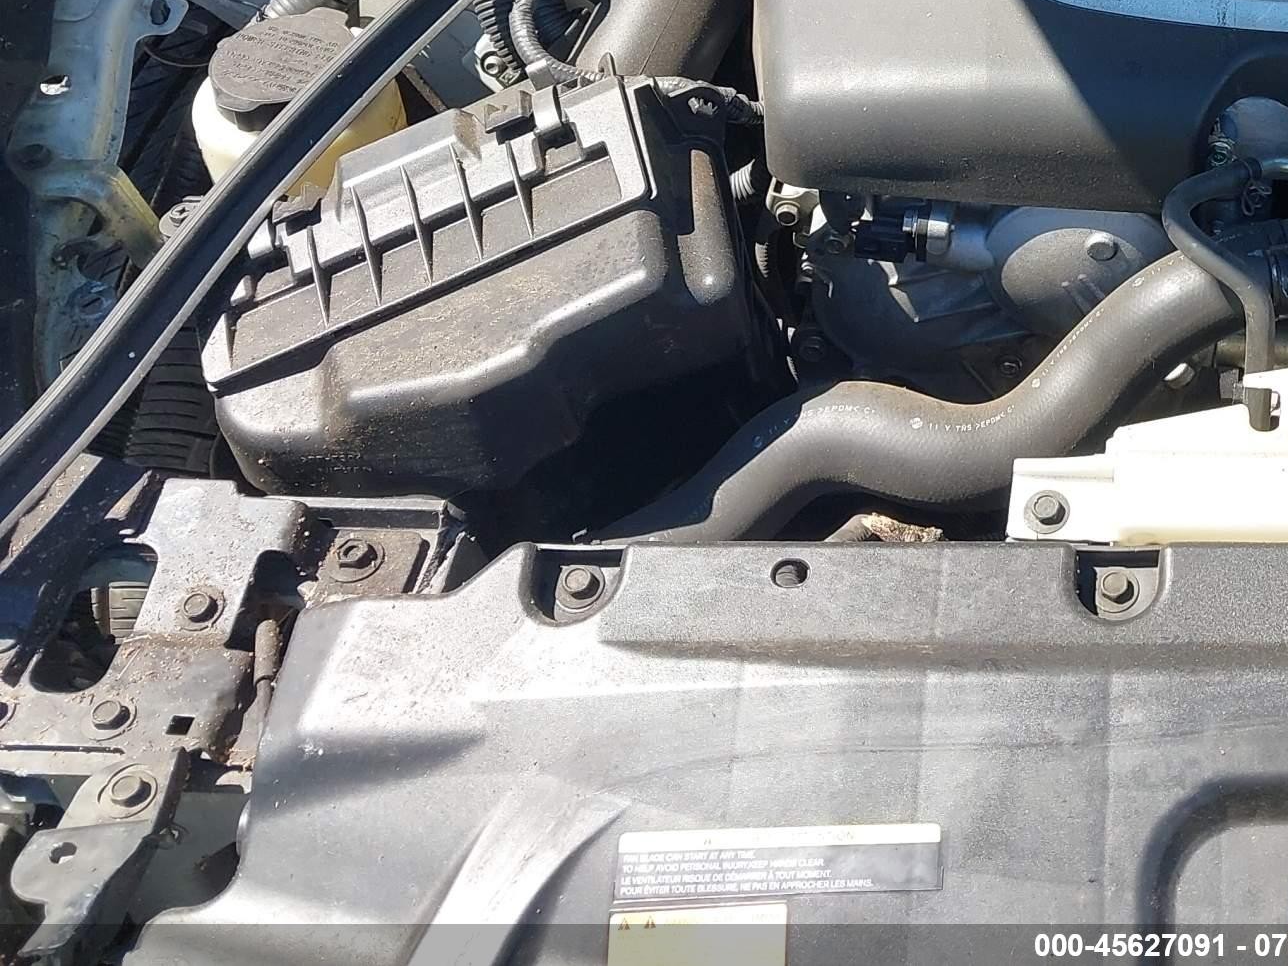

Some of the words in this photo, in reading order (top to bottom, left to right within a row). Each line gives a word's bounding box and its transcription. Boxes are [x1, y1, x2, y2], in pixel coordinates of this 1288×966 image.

[622, 864, 634, 874] TO
[655, 863, 680, 873] AVOID
[681, 861, 722, 872] PERSONAL
[621, 876, 632, 886] LE
[632, 874, 682, 886] VENTILATEUR
[682, 873, 712, 884] RISQUE
[775, 870, 797, 880] TOUT
[620, 886, 642, 897] POUR
[671, 883, 697, 894] TOUTE
[740, 882, 752, 891] NE
[769, 880, 781, 891] EN
[780, 879, 830, 891] APPROCHER
[830, 879, 846, 888] LES
